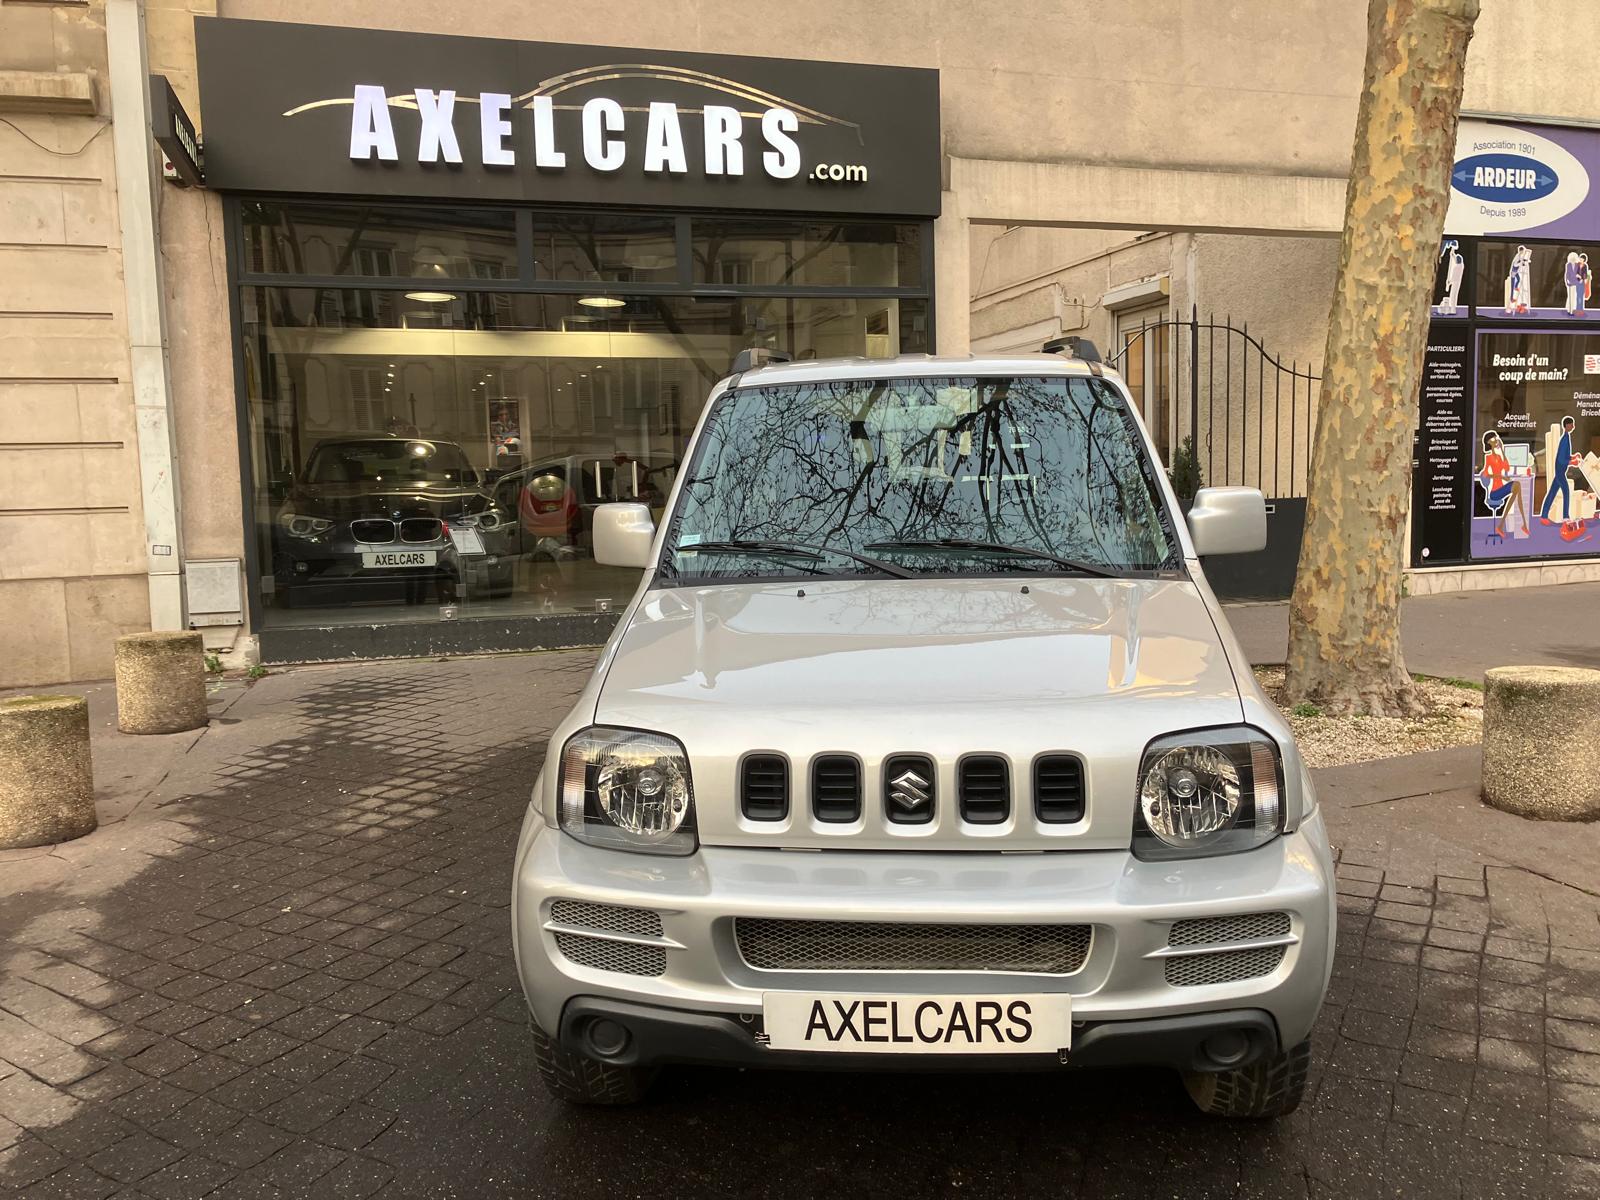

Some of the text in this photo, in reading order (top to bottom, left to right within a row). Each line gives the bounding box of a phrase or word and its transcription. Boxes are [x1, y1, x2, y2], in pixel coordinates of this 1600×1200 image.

[350, 85, 868, 182] AXELCARS .com
[1473, 140, 1536, 155] Association 1901
[1473, 166, 1536, 190] ARDEUR
[1480, 205, 1526, 218] Depuis 1989
[1492, 353, 1549, 367] Besoin d'un
[1499, 368, 1568, 384] coup de main?
[1573, 392, 1600, 400] Déména
[1497, 420, 1537, 428] Secrétariat
[1504, 413, 1530, 421] Accueil
[375, 554, 425, 565] AXELCARS
[804, 999, 1033, 1044] AXELCARS
